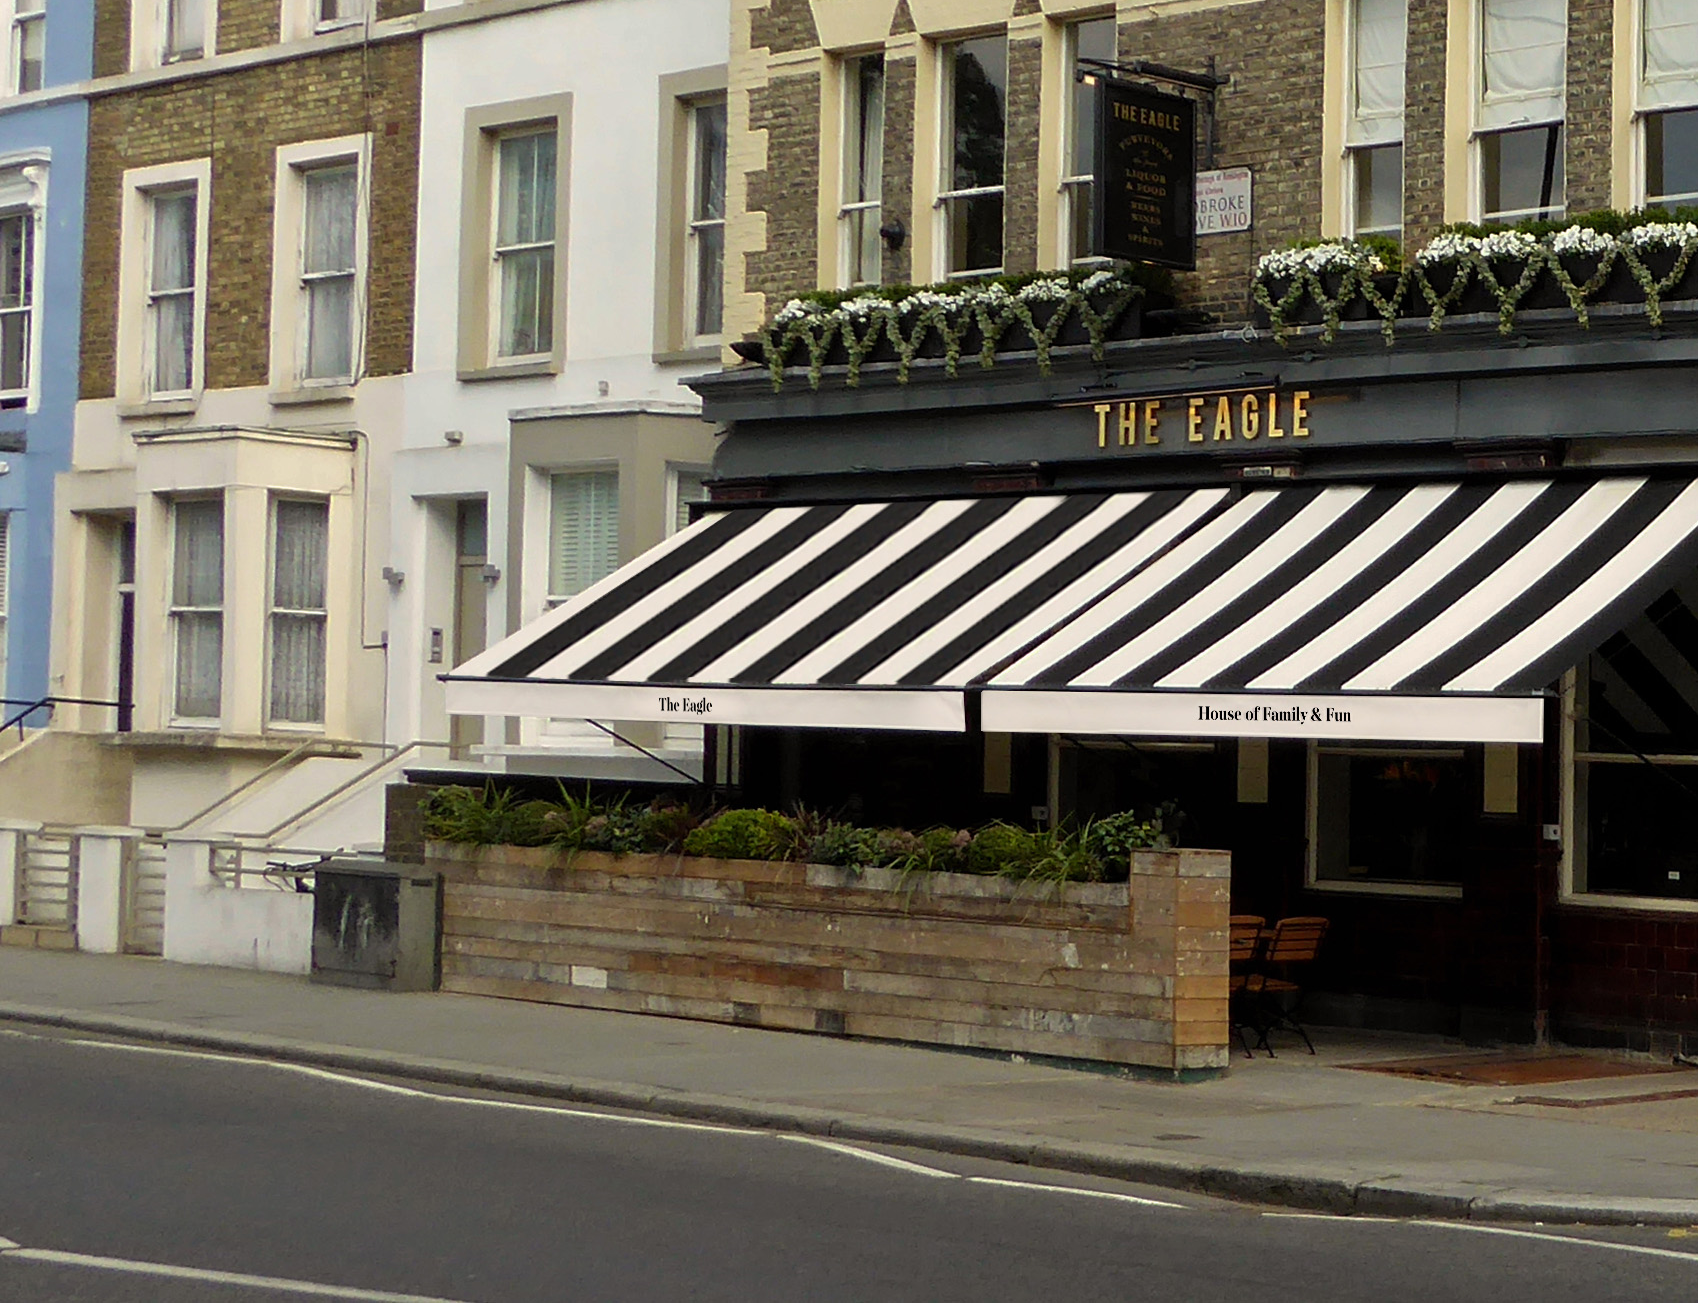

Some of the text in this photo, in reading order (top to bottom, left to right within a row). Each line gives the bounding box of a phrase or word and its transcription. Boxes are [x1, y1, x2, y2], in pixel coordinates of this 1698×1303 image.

[1112, 101, 1182, 132] THE EAGLE
[1125, 168, 1167, 185] LIQUOR
[1137, 183, 1167, 197] FOOD
[1197, 195, 1245, 214] BROKE
[1094, 390, 1311, 448] THE EAGLE
[658, 697, 713, 716] The Eagle
[1198, 705, 1352, 725] House of Family & Fun
